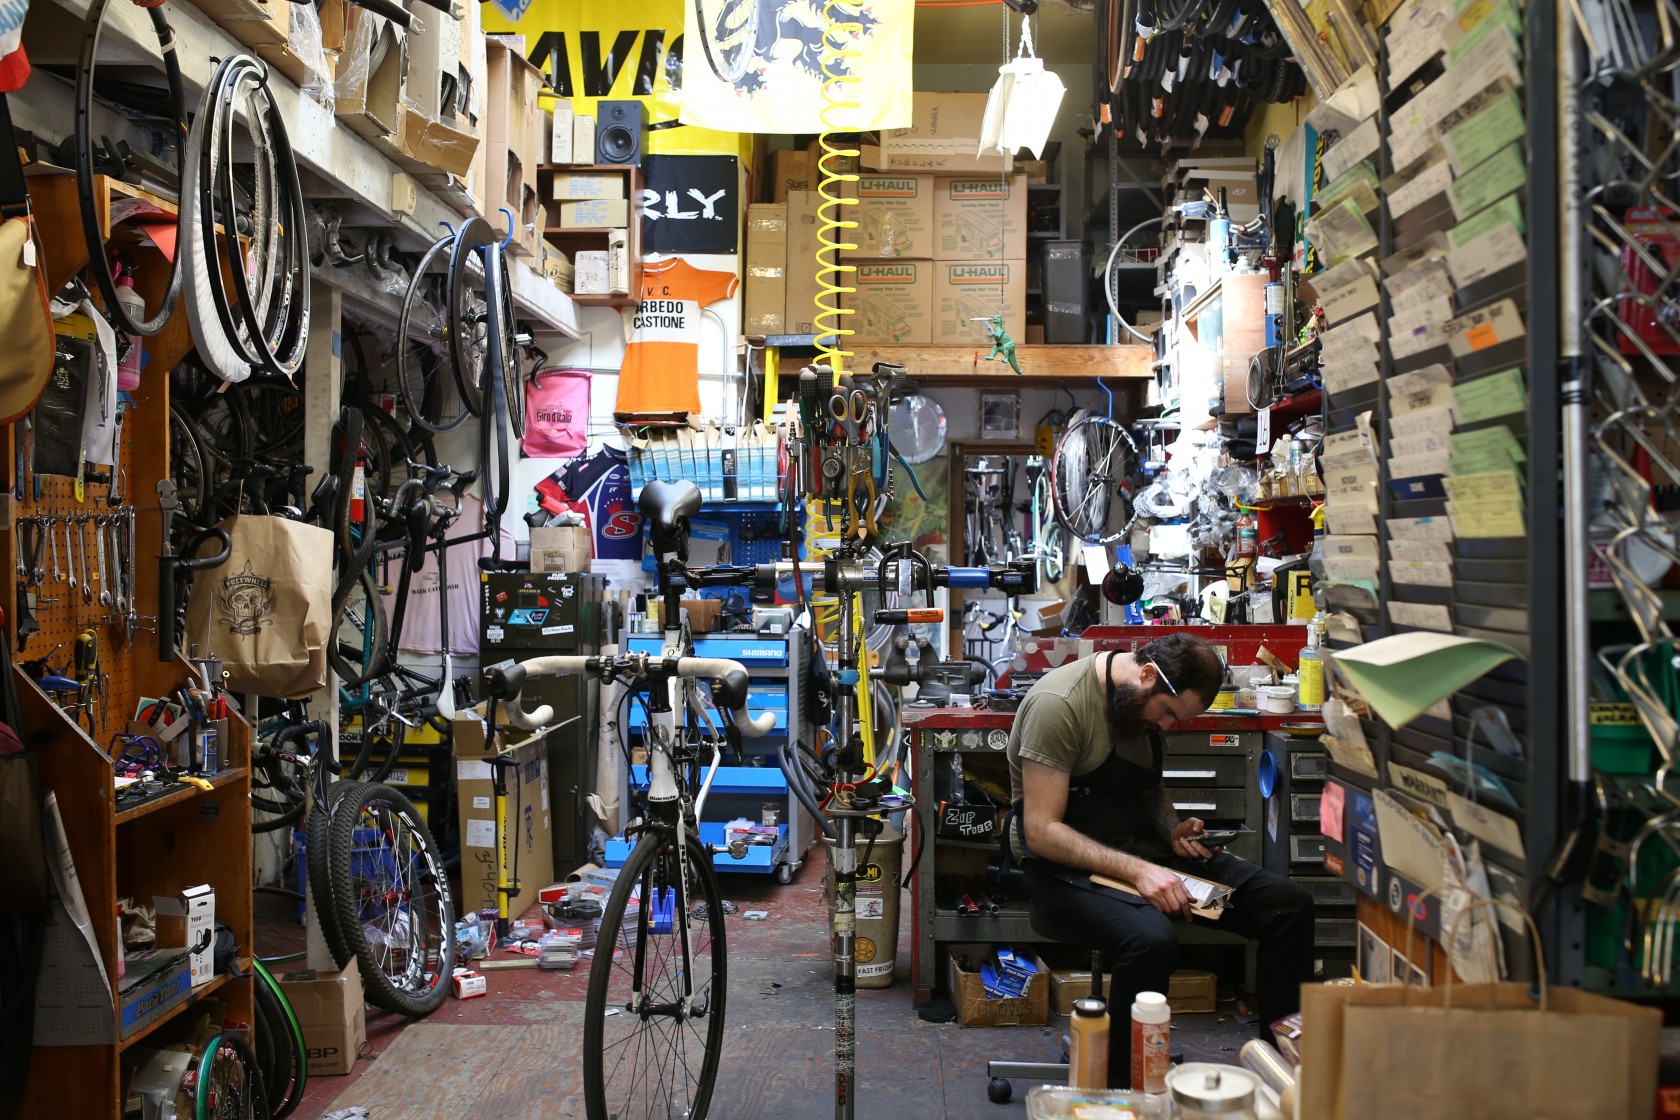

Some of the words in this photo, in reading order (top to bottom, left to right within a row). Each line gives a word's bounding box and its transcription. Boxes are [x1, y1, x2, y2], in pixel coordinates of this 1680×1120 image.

[486, 29, 684, 97] AVI
[861, 181, 914, 190] U-HAUL
[954, 183, 1006, 193] U-HAUL
[861, 267, 912, 276] U-HAUL
[953, 268, 1005, 277] U-HAUL
[635, 301, 683, 314] ARBEDO
[633, 316, 685, 329] CASTIONE
[536, 411, 551, 421] Giro
[551, 411, 573, 423] d'Italia
[226, 577, 268, 587] FREEWHEEL
[742, 649, 783, 657] SHIMANO
[946, 809, 975, 824] ZIP
[960, 820, 993, 835] TIES
[858, 966, 874, 975] FAST
[978, 1002, 1033, 1016] GLOVES
